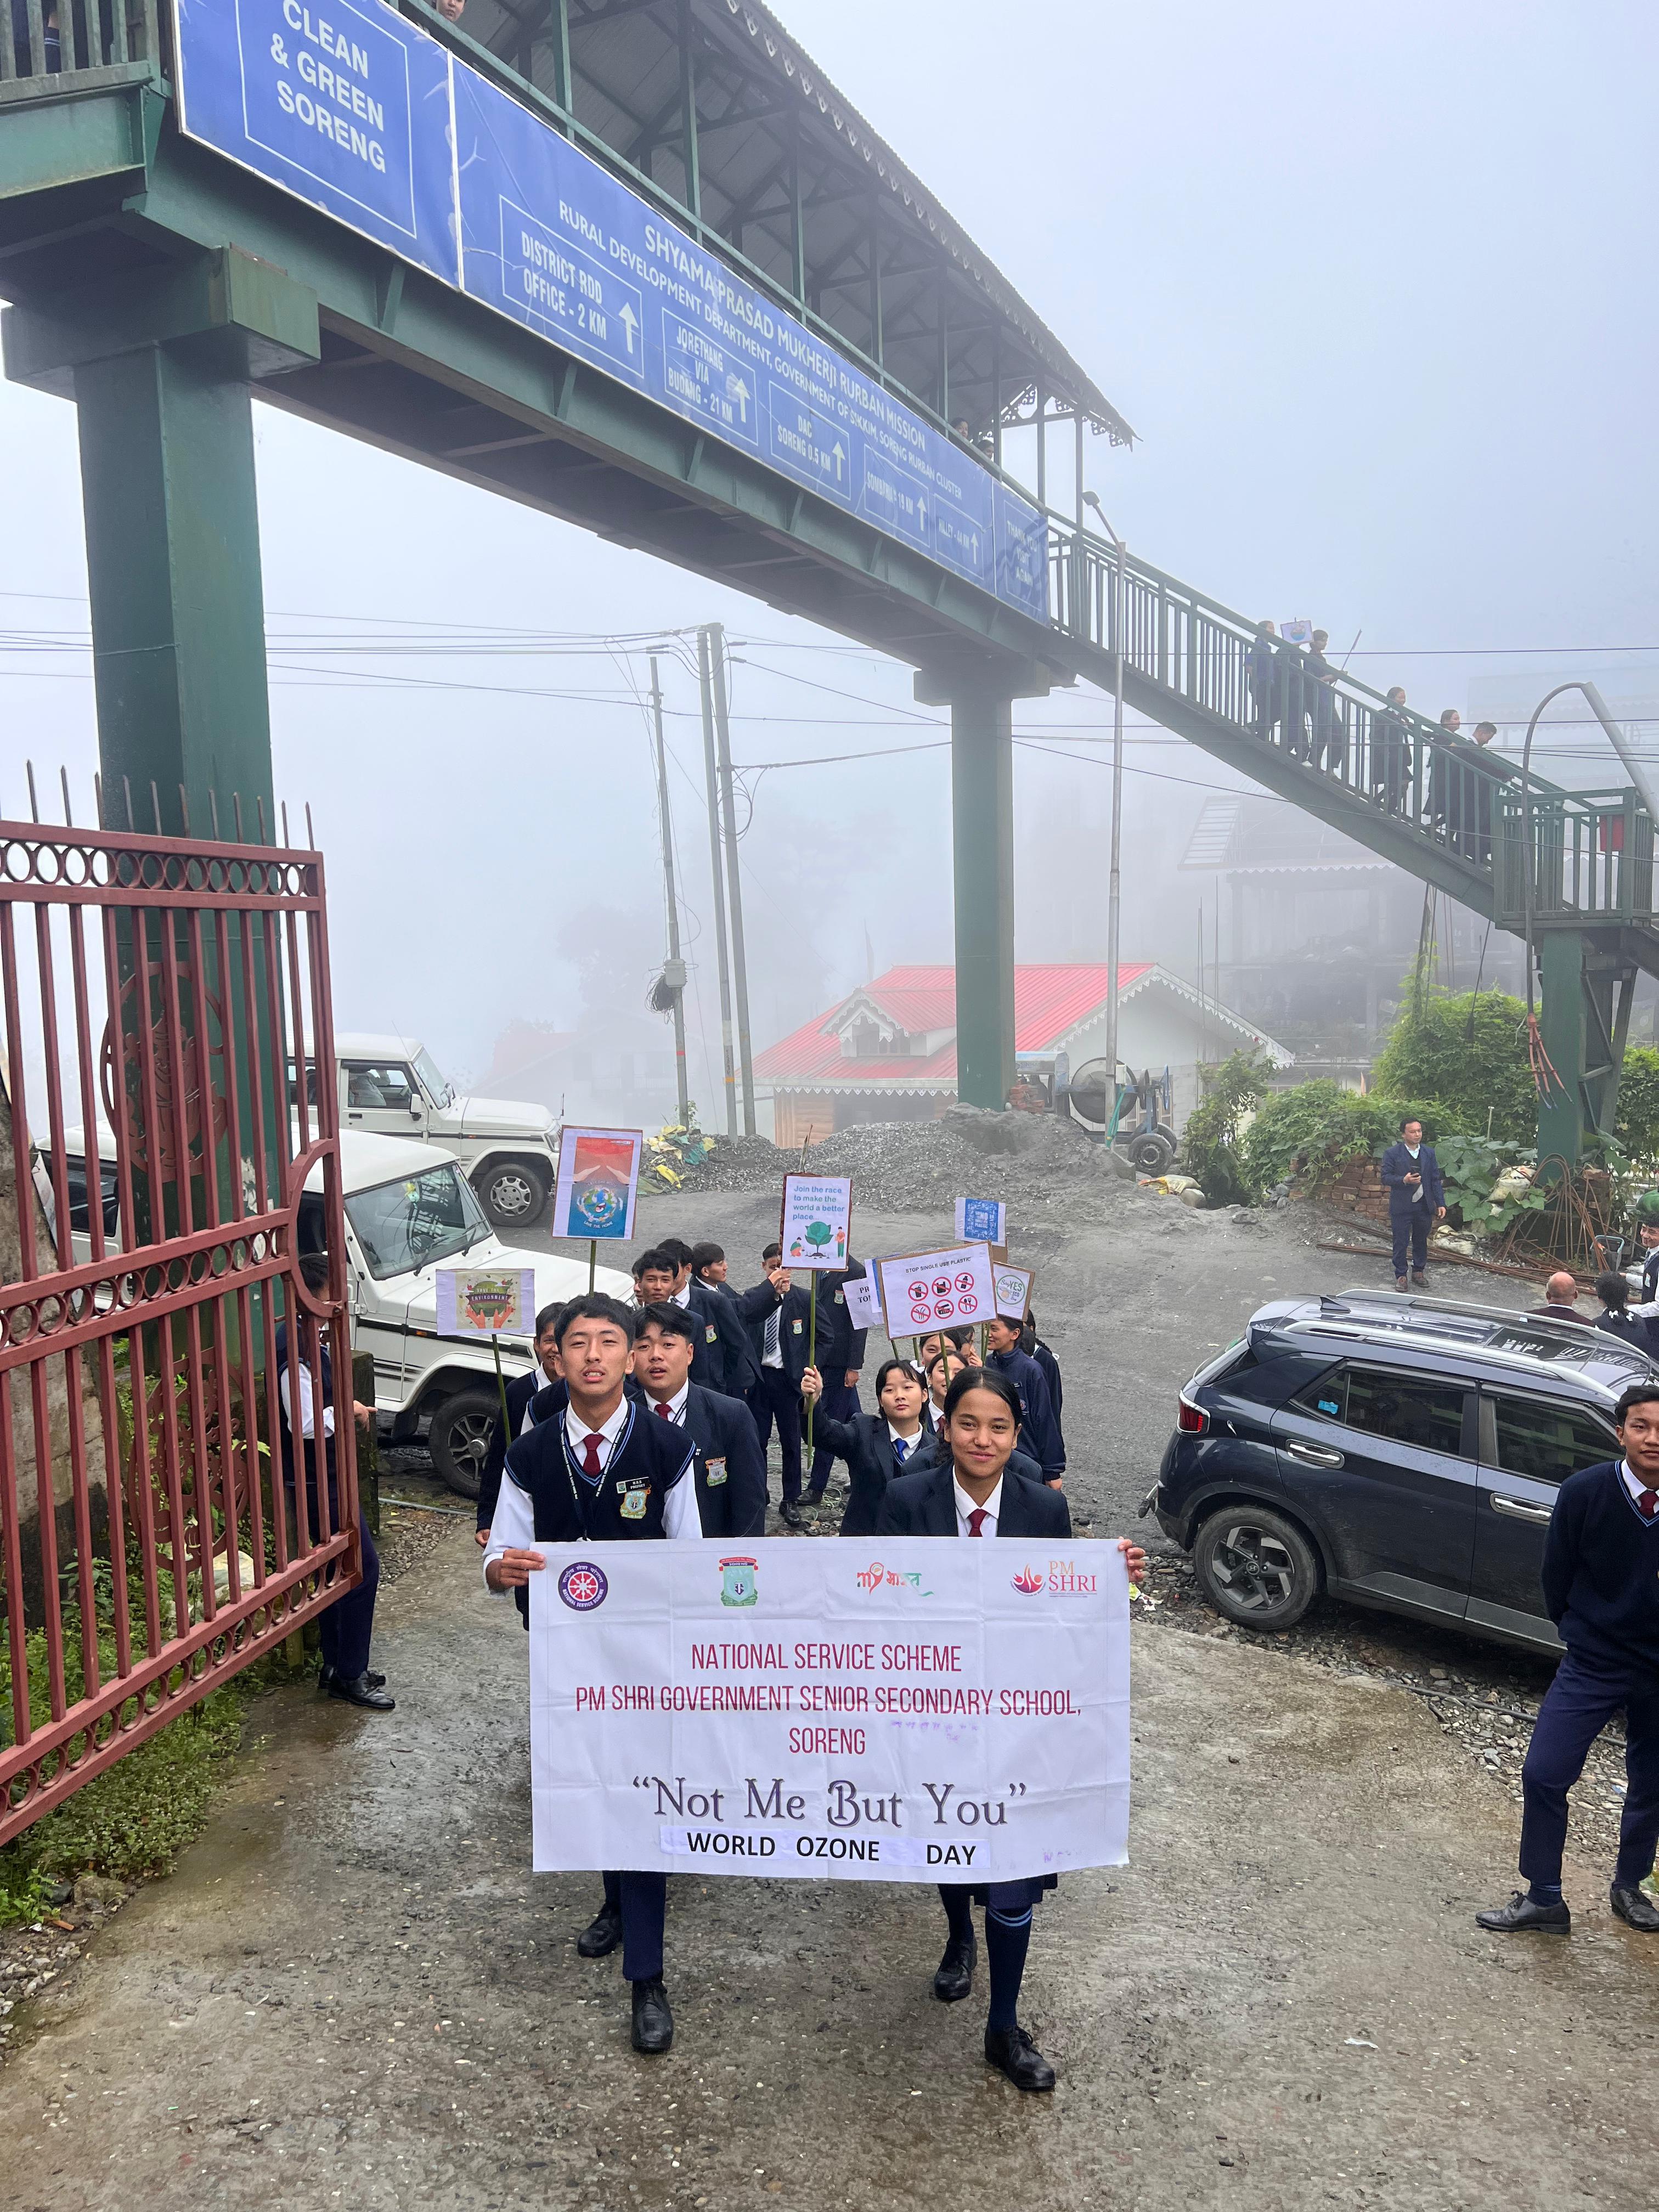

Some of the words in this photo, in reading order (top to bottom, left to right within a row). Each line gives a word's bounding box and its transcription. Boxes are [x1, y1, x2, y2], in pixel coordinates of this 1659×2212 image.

[283, 0, 368, 79] CLEAN
[270, 33, 290, 69] &
[297, 51, 383, 132] GREEN
[276, 80, 386, 173] SORENG
[521, 230, 575, 288] DISTRICT
[579, 269, 602, 304] RDD
[523, 267, 566, 317] OFFICE
[568, 308, 574, 316] -
[578, 302, 585, 329] 2
[589, 308, 607, 341] KM
[559, 199, 606, 251] RURAL
[610, 236, 702, 315] DEVELOPMENT
[704, 303, 772, 370] DEPARTMENT,
[774, 356, 836, 410] GOVERNMENT
[837, 401, 849, 419] OF
[850, 410, 878, 442] SIKKIM,
[879, 430, 907, 461] SORENG
[909, 451, 935, 481] RURBAN
[936, 472, 962, 500] CLUSTER
[645, 224, 717, 299] SHYAMA
[718, 278, 774, 340] PRASAD
[777, 324, 837, 389] MUKHERJI
[840, 371, 885, 421] RURBAN
[887, 406, 926, 452] MISSION
[676, 325, 723, 372] JORETHANG
[695, 359, 709, 385] VIA
[668, 366, 701, 405] BUDANG
[710, 393, 719, 415] 21
[721, 400, 733, 424] KM
[798, 414, 812, 438] DAC
[777, 424, 806, 457] SORENG
[808, 443, 819, 465] 0.5
[820, 450, 831, 472] KM
[905, 495, 913, 516] KM
[1007, 520, 1026, 545] THANK
[1026, 534, 1037, 552] YOU
[1016, 546, 1031, 567] VISIT
[1016, 566, 1033, 588] AGAIN
[980, 1211, 988, 1221] NO
[950, 1257, 971, 1265] PLASTIC
[1009, 1280, 1023, 1292] YES
[1048, 1560, 1075, 1575] PM
[1048, 1575, 1097, 1592] SHRI
[691, 1644, 788, 1669] NATIONAL
[794, 1643, 875, 1669] SERVICE
[881, 1644, 962, 1672] SCHEME
[576, 1685, 605, 1711] PM
[611, 1685, 654, 1711] SHRI
[660, 1685, 794, 1711] GOVERNMENT
[799, 1685, 868, 1712] SENIOR
[874, 1687, 994, 1715] SECONDARY
[1000, 1689, 1081, 1717] SCHOOL,
[789, 1727, 866, 1755] SORENG
[633, 1775, 725, 1822] “Not
[744, 1778, 806, 1820] Me
[826, 1779, 903, 1828] But
[922, 1782, 1027, 1826] You”
[686, 1832, 776, 1857] WORLD
[797, 1836, 880, 1861] OZONE
[926, 1844, 977, 1866] DAY
